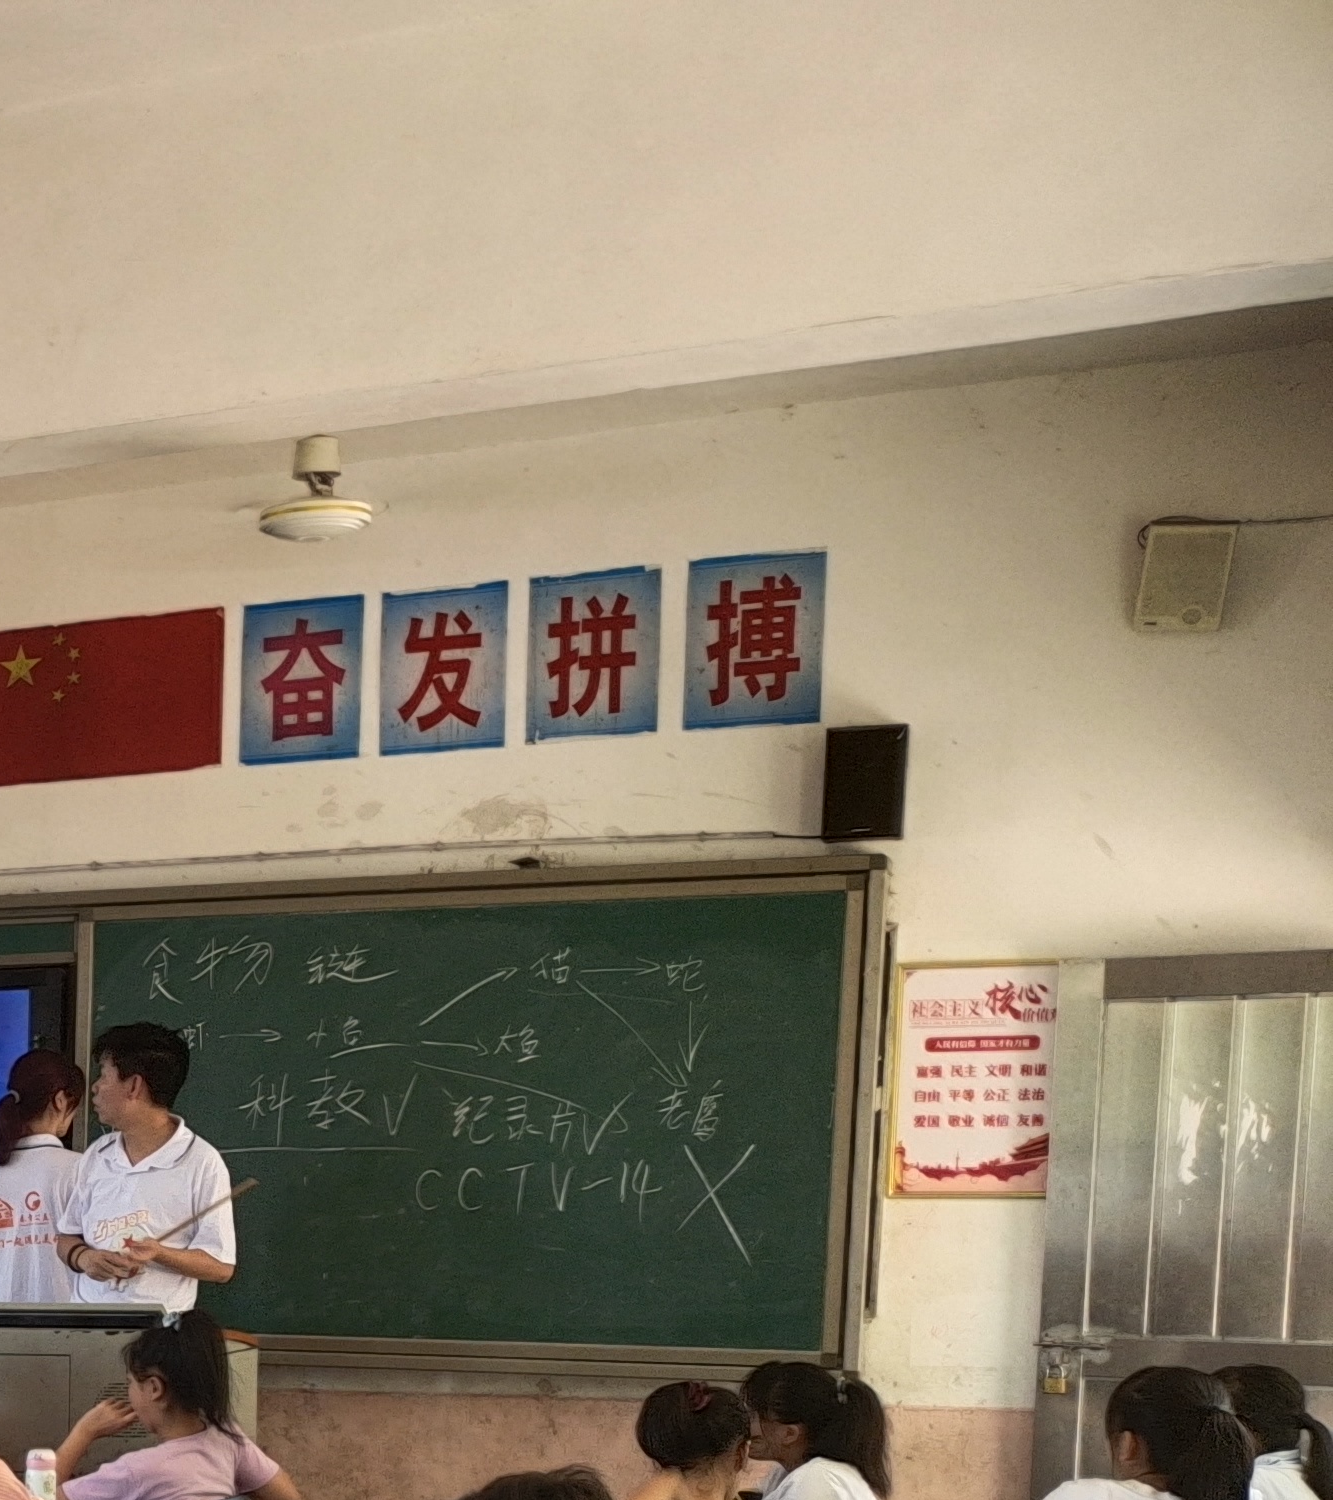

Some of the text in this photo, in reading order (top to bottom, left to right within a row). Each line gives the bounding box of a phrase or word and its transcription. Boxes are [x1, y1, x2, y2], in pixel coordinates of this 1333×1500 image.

[261, 572, 802, 742] 奋发拼搏
[911, 1000, 982, 1018] 社会主义
[984, 980, 1048, 1019] 核心
[916, 1063, 1047, 1078] 富强 民主 文明 和谐
[914, 1087, 1045, 1103] 自由 平等 公正 法治
[914, 1113, 1044, 1128] 爱国 敬业 诚信 友善
[416, 1159, 663, 1222] CCTV-14
